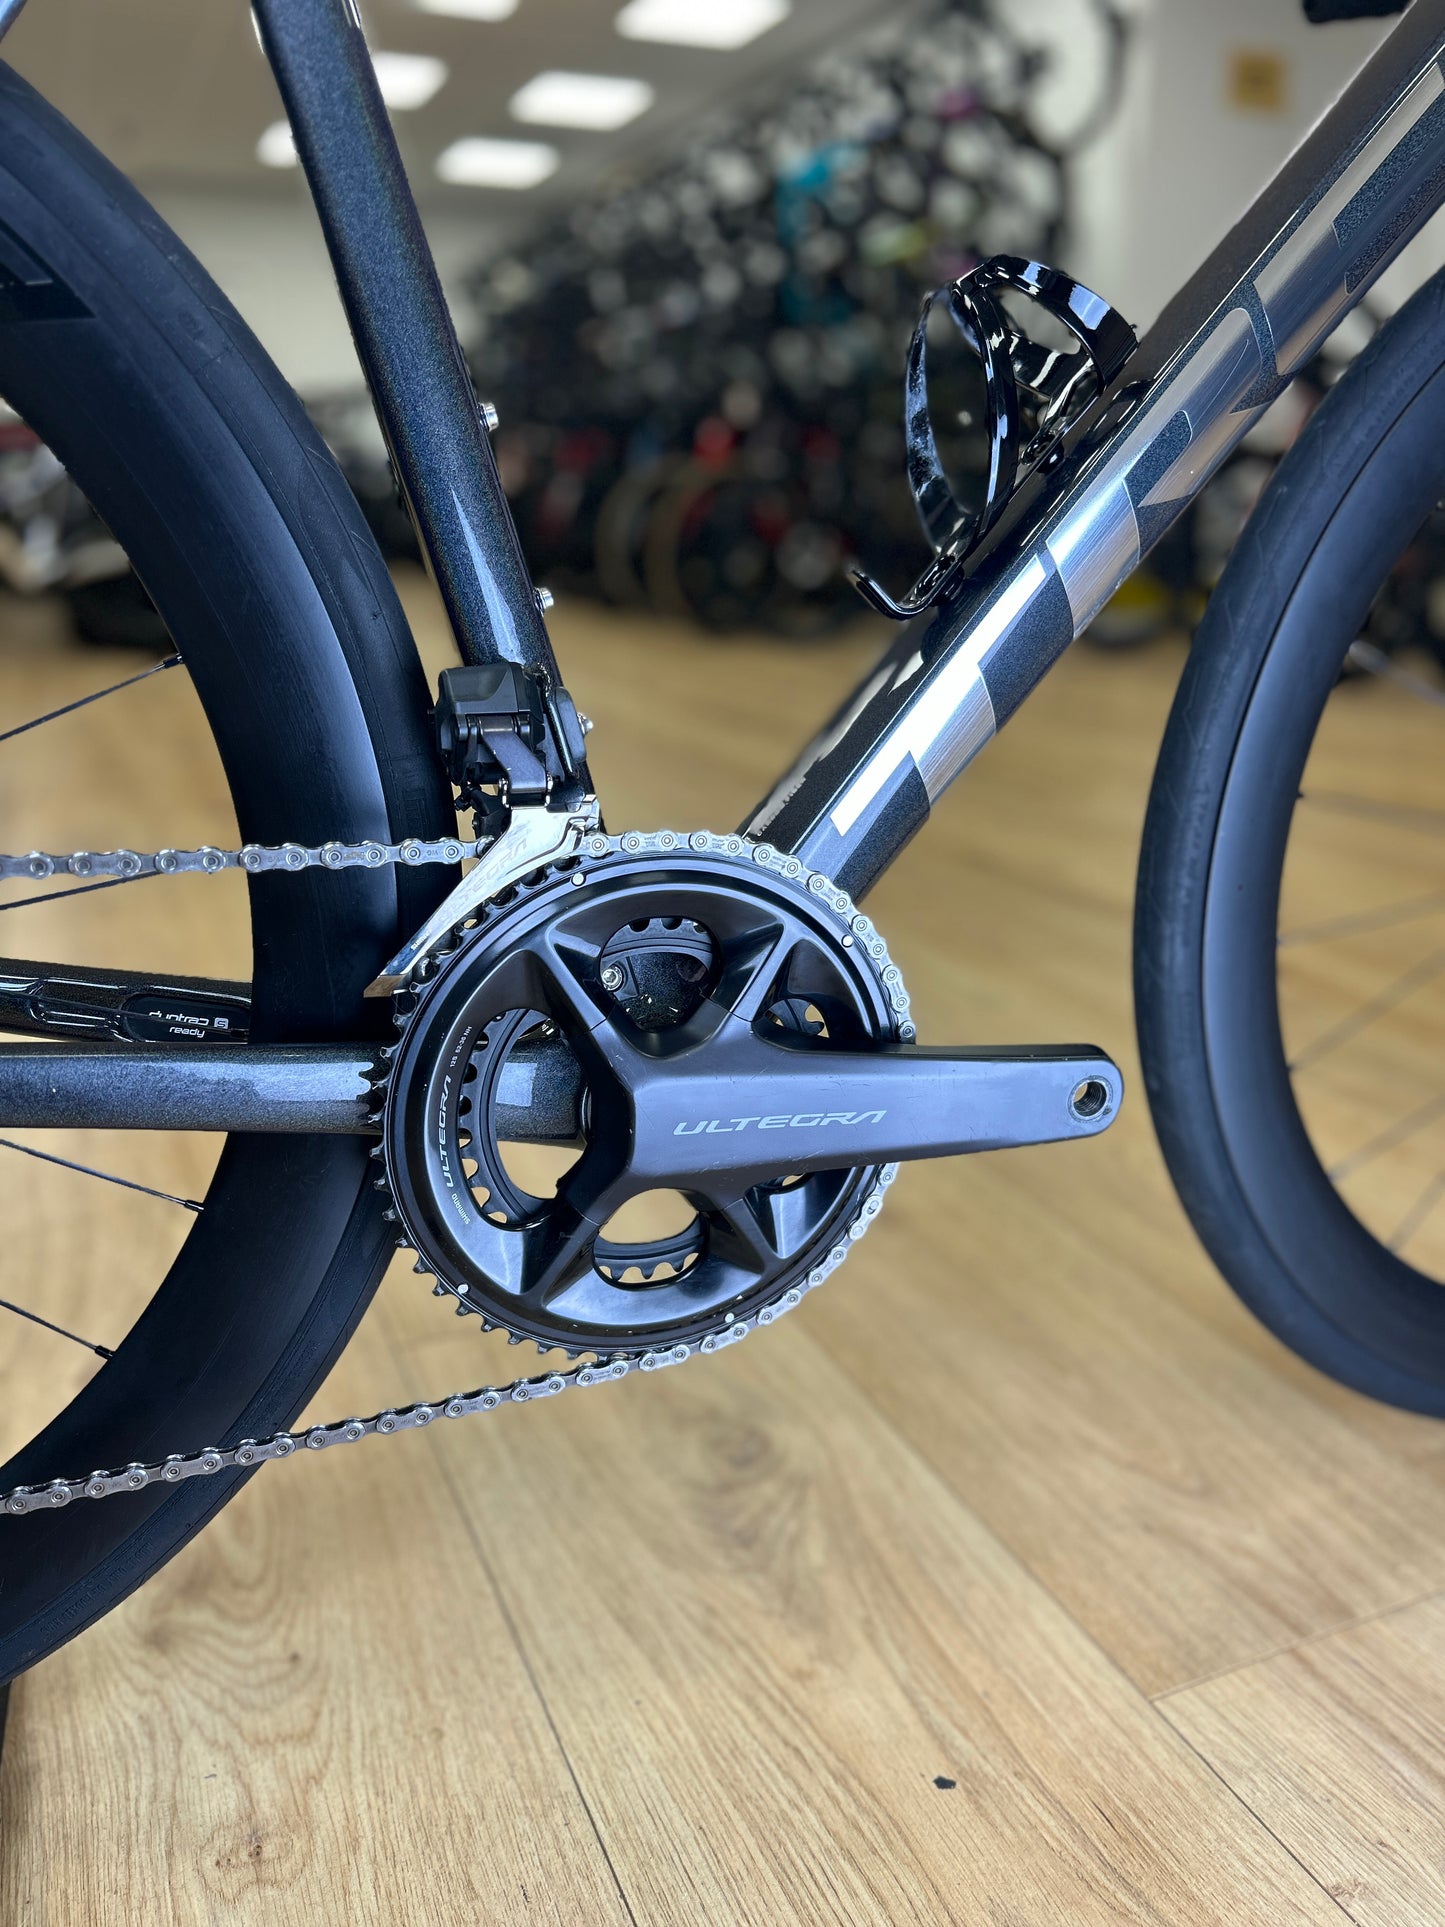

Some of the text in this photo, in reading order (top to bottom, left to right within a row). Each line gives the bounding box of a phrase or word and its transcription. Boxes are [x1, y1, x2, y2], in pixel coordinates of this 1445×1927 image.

[169, 1026, 206, 1038] ready
[438, 1074, 454, 1188] ULTEGRA
[673, 1110, 887, 1136] ULTEGRA
[451, 1193, 470, 1225] SHIMANO
